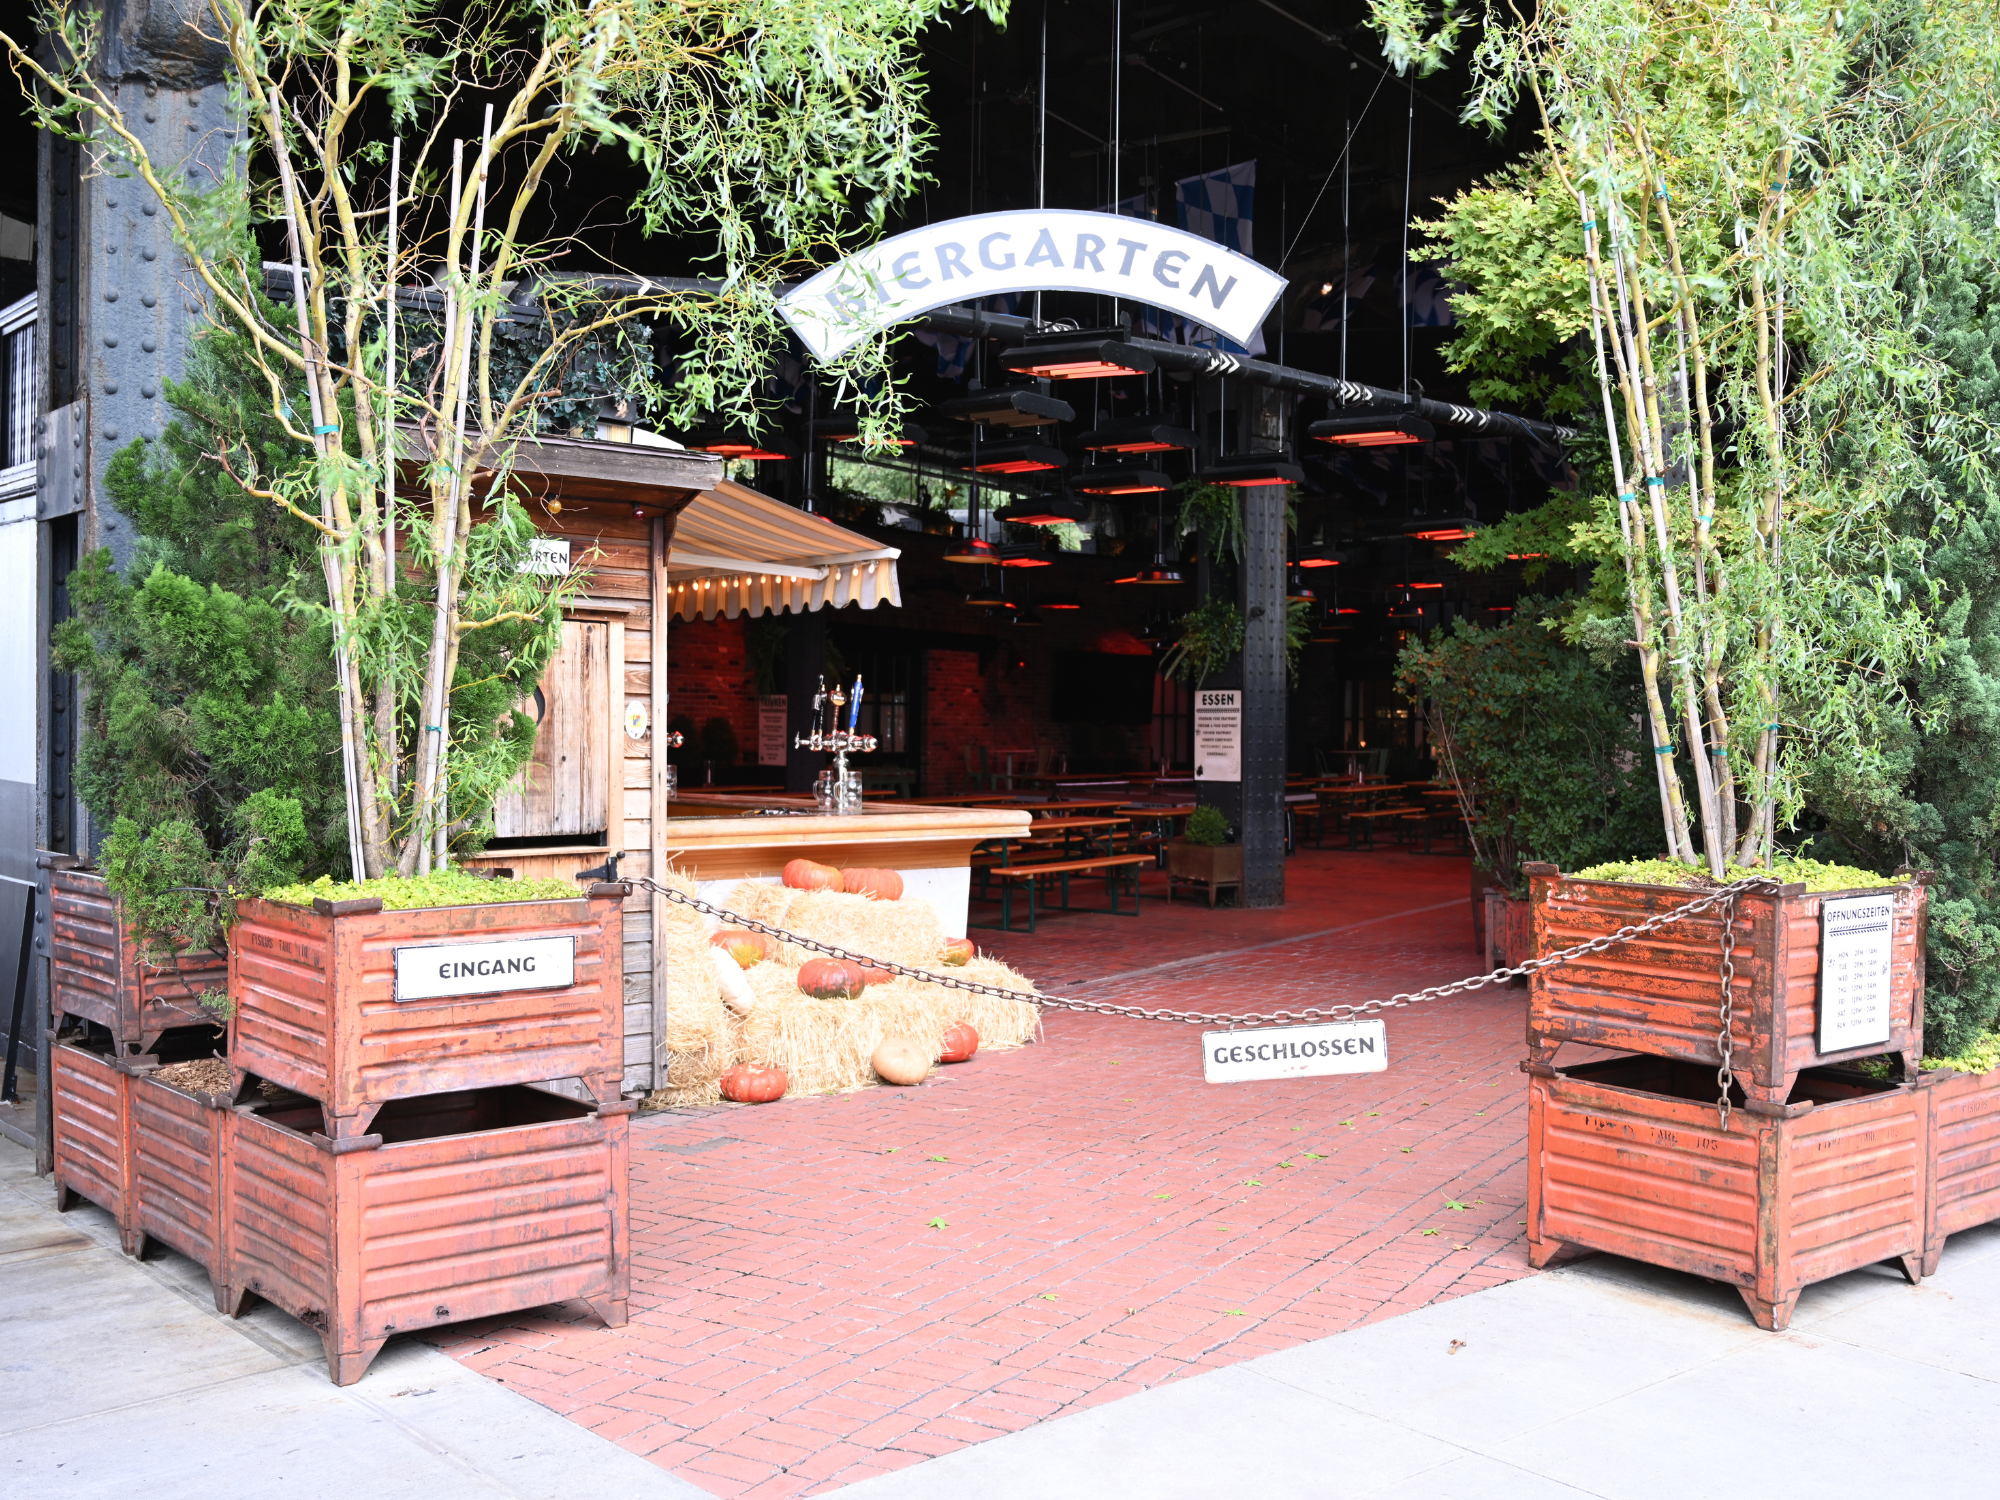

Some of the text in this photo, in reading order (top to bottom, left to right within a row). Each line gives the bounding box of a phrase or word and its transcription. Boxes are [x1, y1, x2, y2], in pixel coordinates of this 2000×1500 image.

[824, 227, 1238, 324] BIERGARTEN
[1202, 693, 1234, 706] ESSEN
[439, 956, 536, 979] EINGANG
[1213, 1036, 1375, 1064] GESCHLOSSEN
